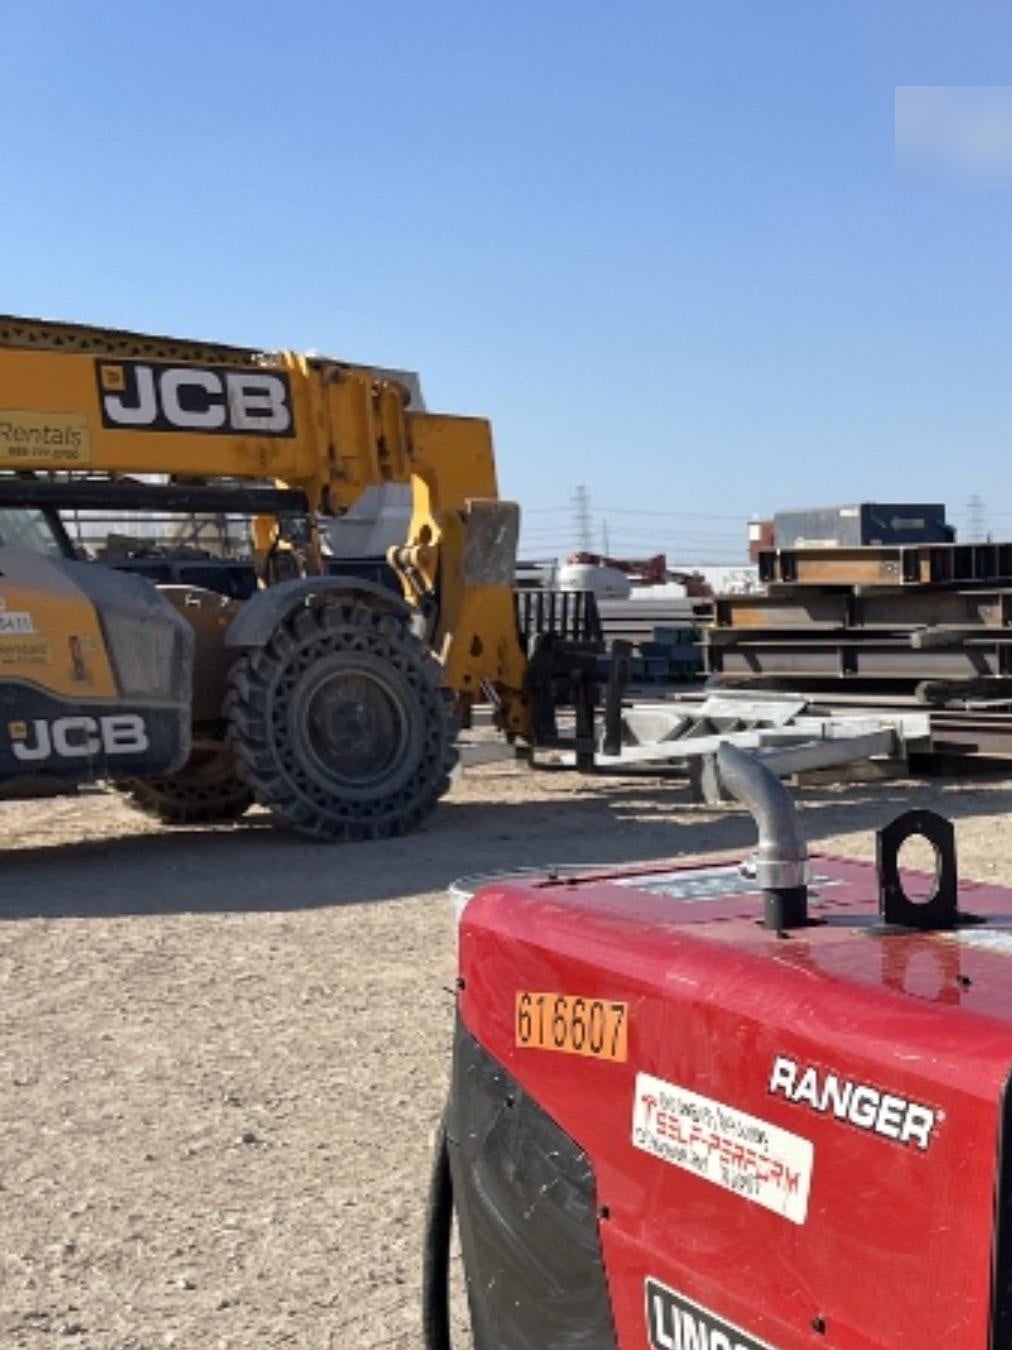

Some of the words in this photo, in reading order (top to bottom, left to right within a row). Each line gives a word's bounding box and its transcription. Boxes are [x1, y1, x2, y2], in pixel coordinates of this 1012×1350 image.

[104, 365, 291, 432] JCB
[12, 714, 149, 760] JCB
[518, 991, 625, 1057] 616607
[769, 1055, 936, 1150] RANGER
